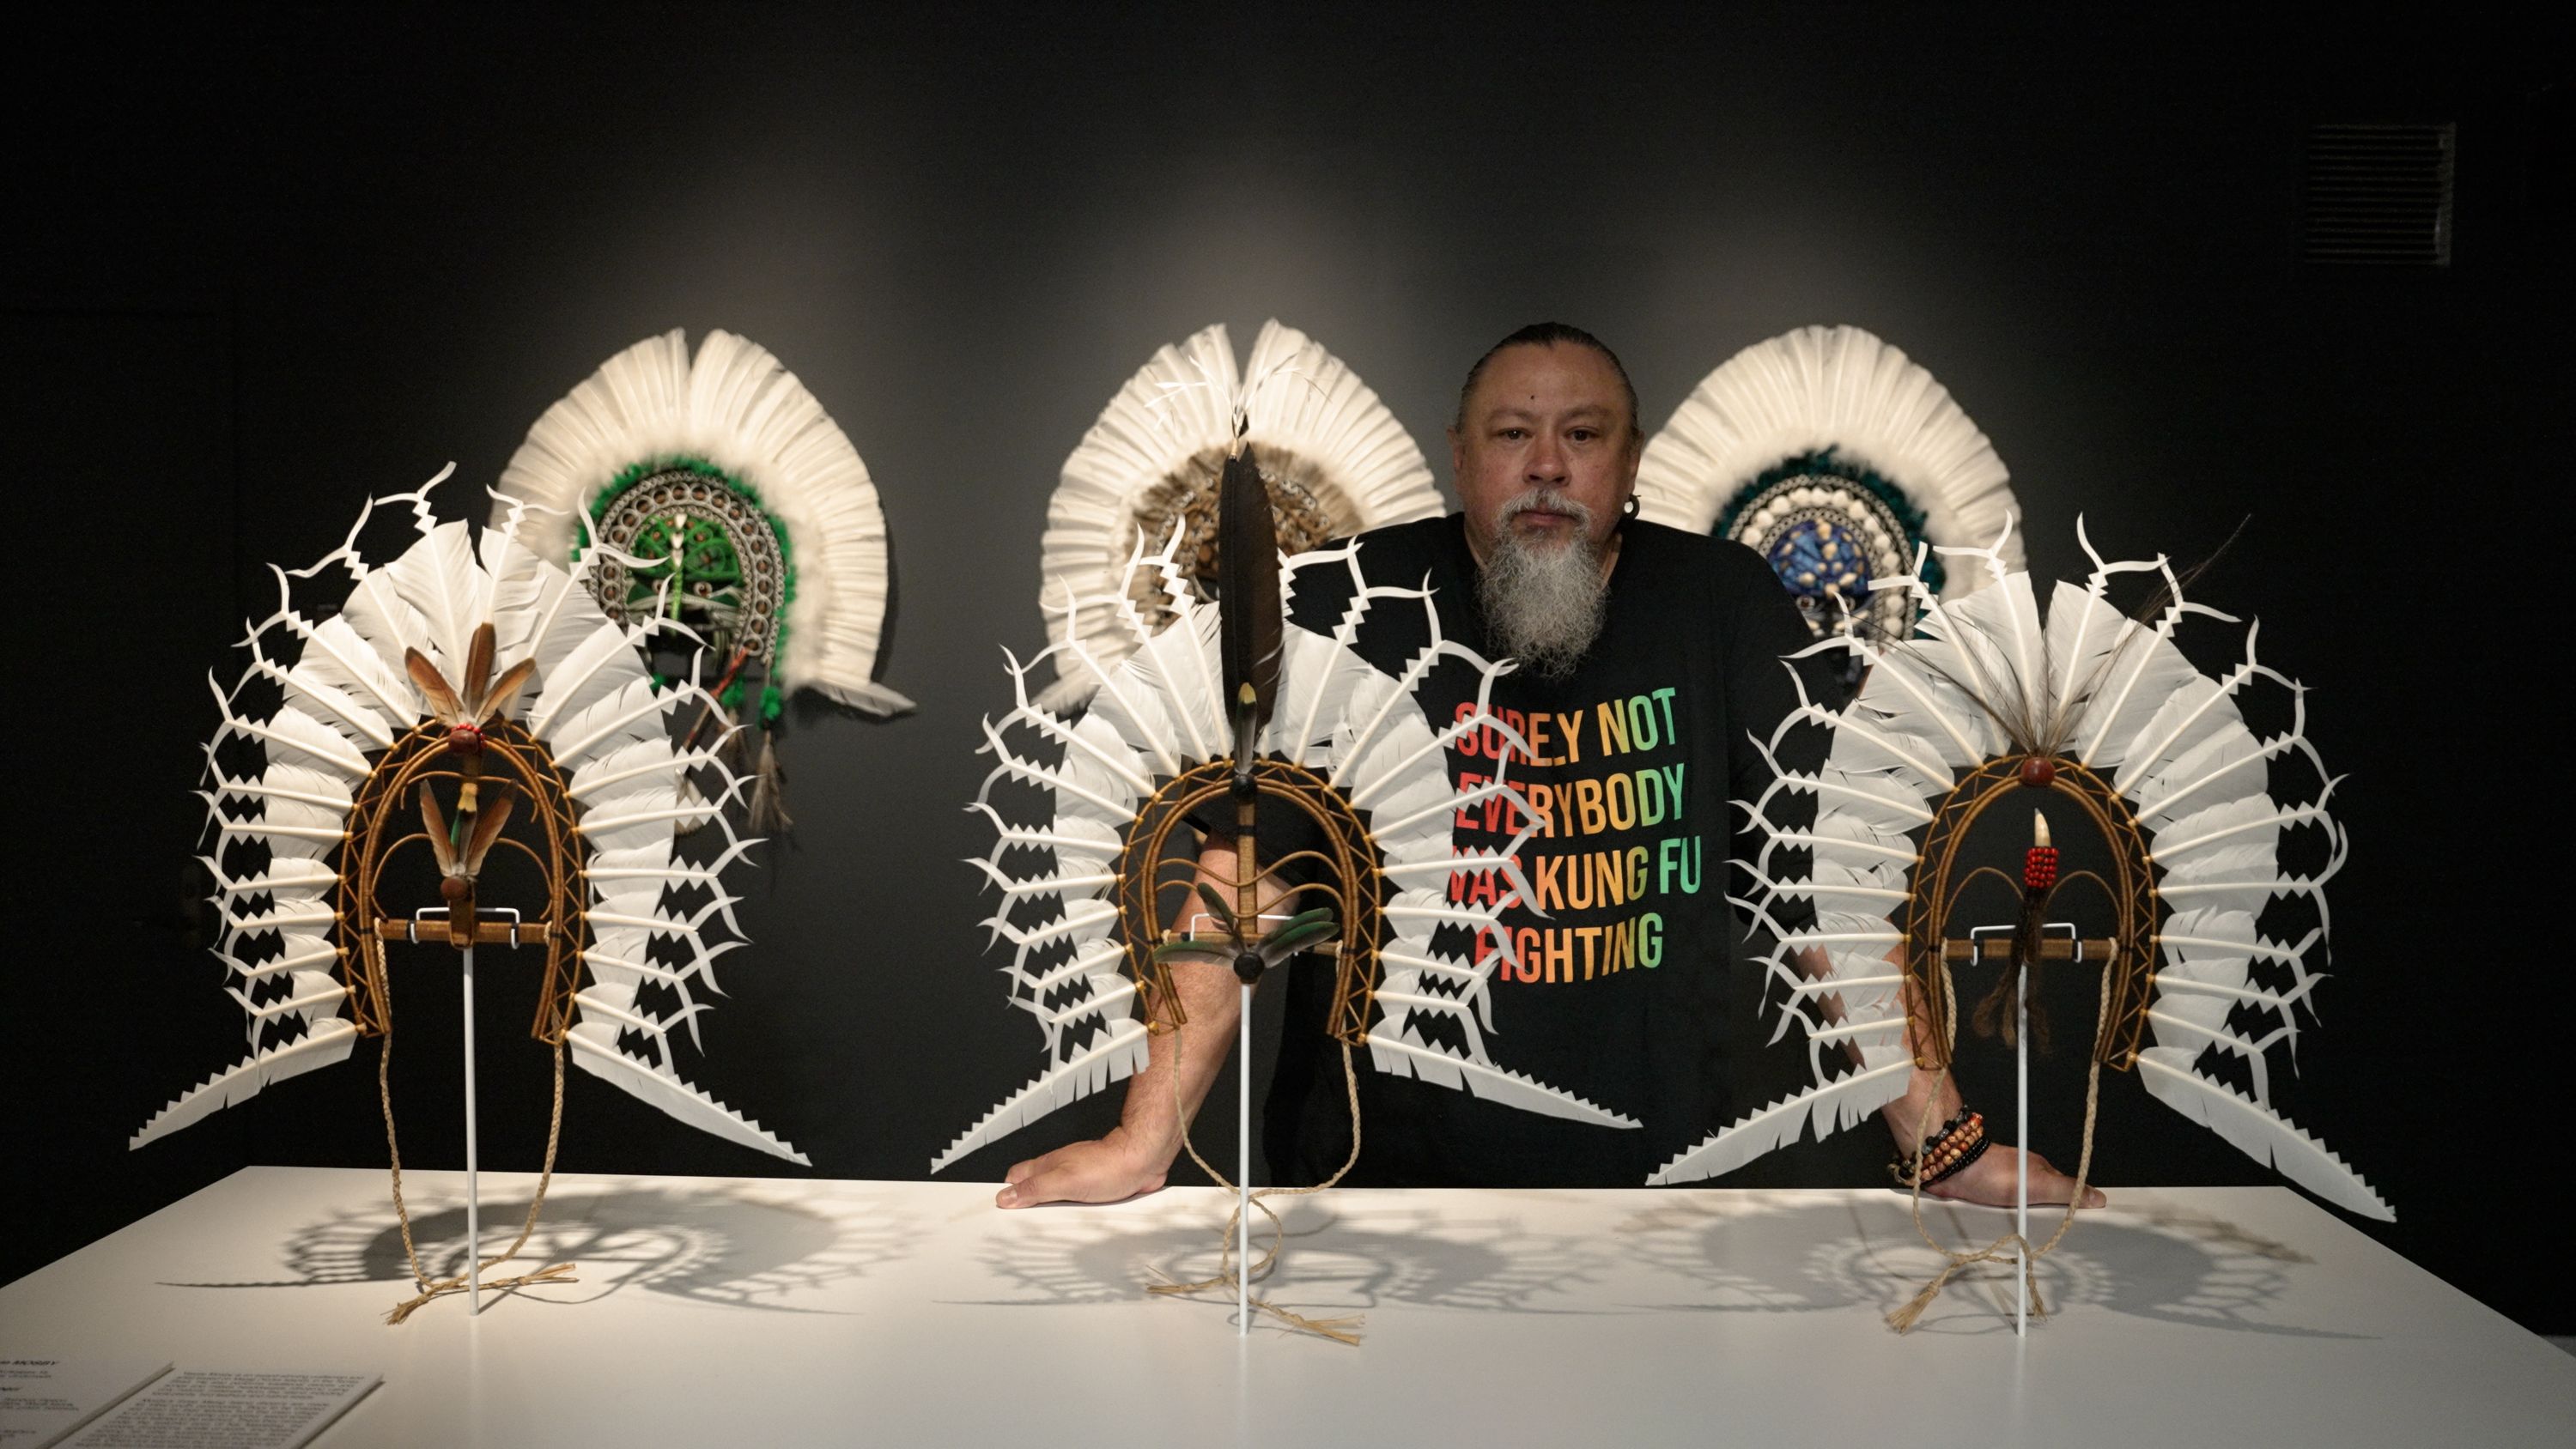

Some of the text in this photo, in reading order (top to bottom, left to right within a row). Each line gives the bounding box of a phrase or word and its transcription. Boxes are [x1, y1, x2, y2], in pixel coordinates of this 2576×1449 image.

[1455, 687, 1676, 767] SUREY NOT
[1455, 762, 1686, 839] EVERYBODY
[1535, 845, 1649, 911] KUNG
[1659, 835, 1702, 894] FU
[1473, 912, 1664, 984] FIGHTING
